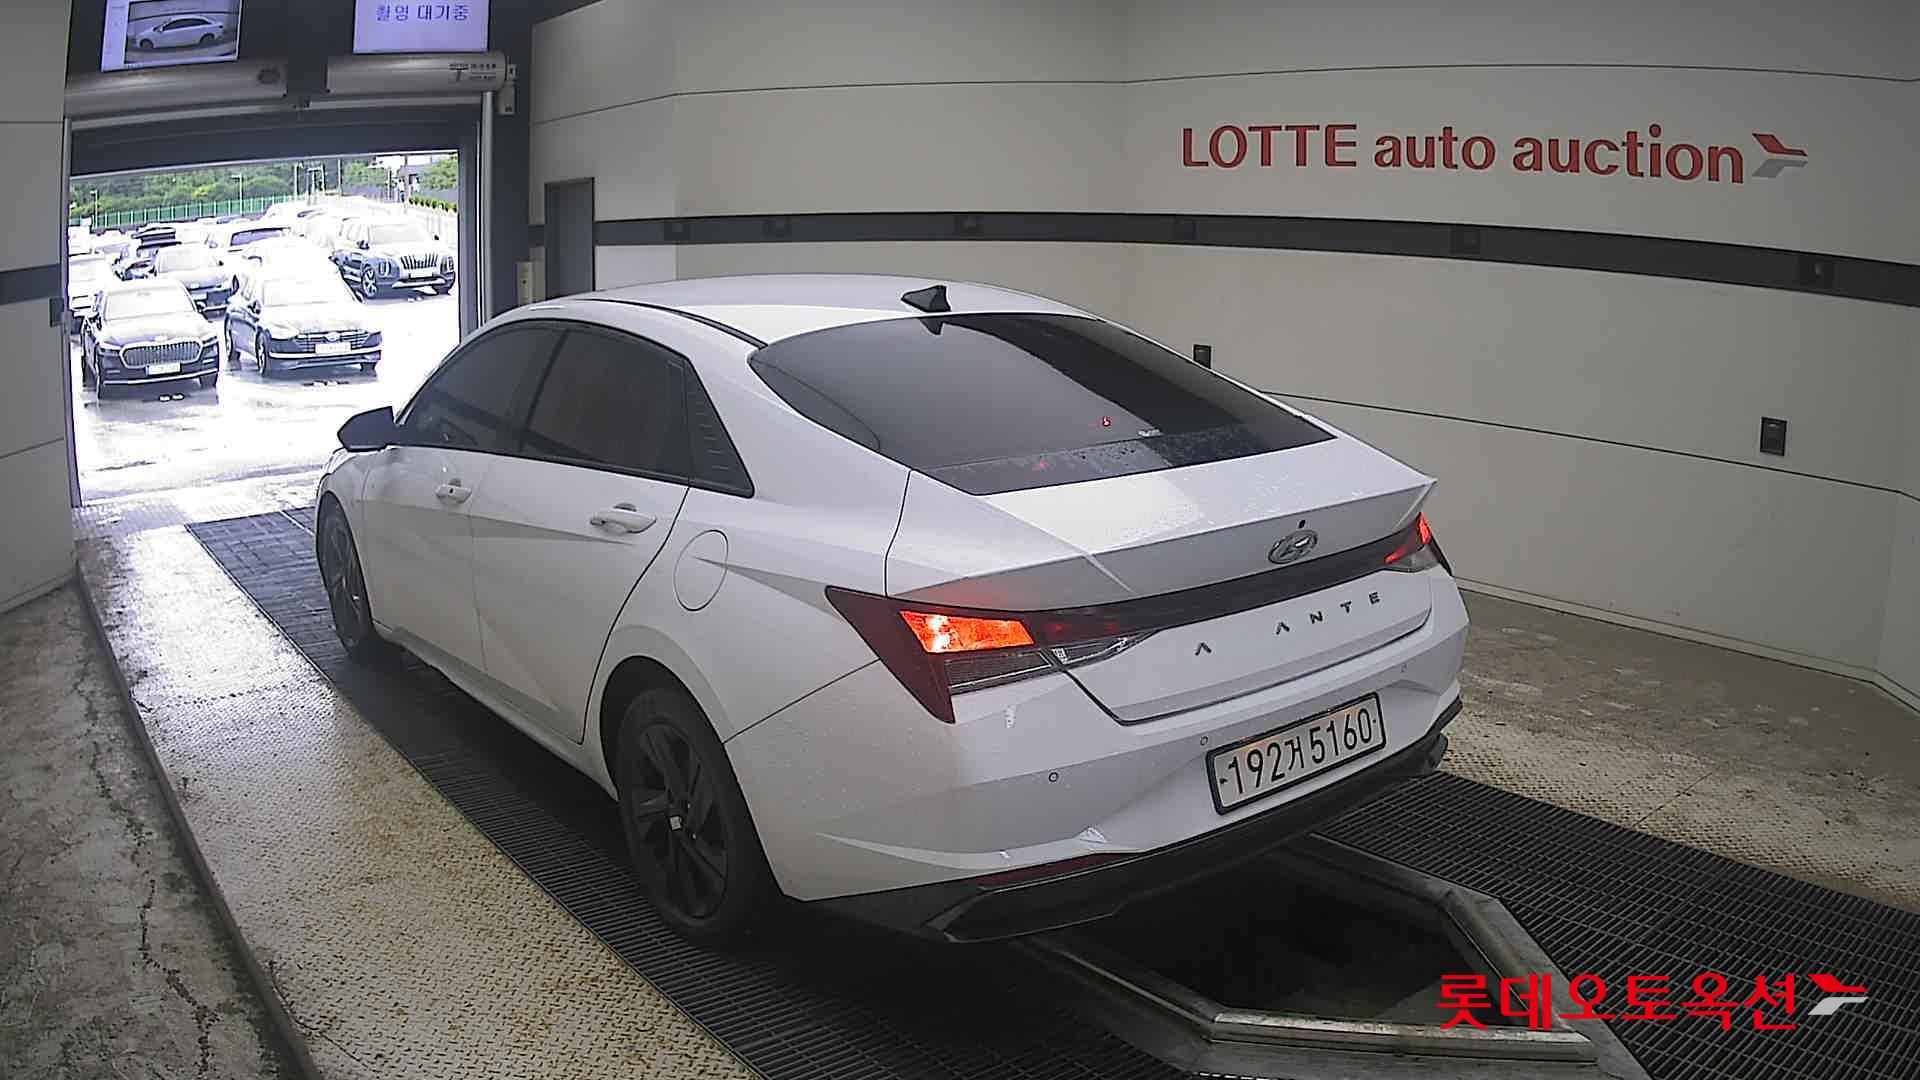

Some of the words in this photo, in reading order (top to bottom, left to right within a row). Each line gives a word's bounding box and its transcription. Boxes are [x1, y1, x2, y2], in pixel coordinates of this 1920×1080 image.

[417, 4, 470, 22] 대기중
[1182, 124, 1358, 168] LOTTE
[1374, 126, 1496, 171] auto
[1512, 124, 1744, 184] auction
